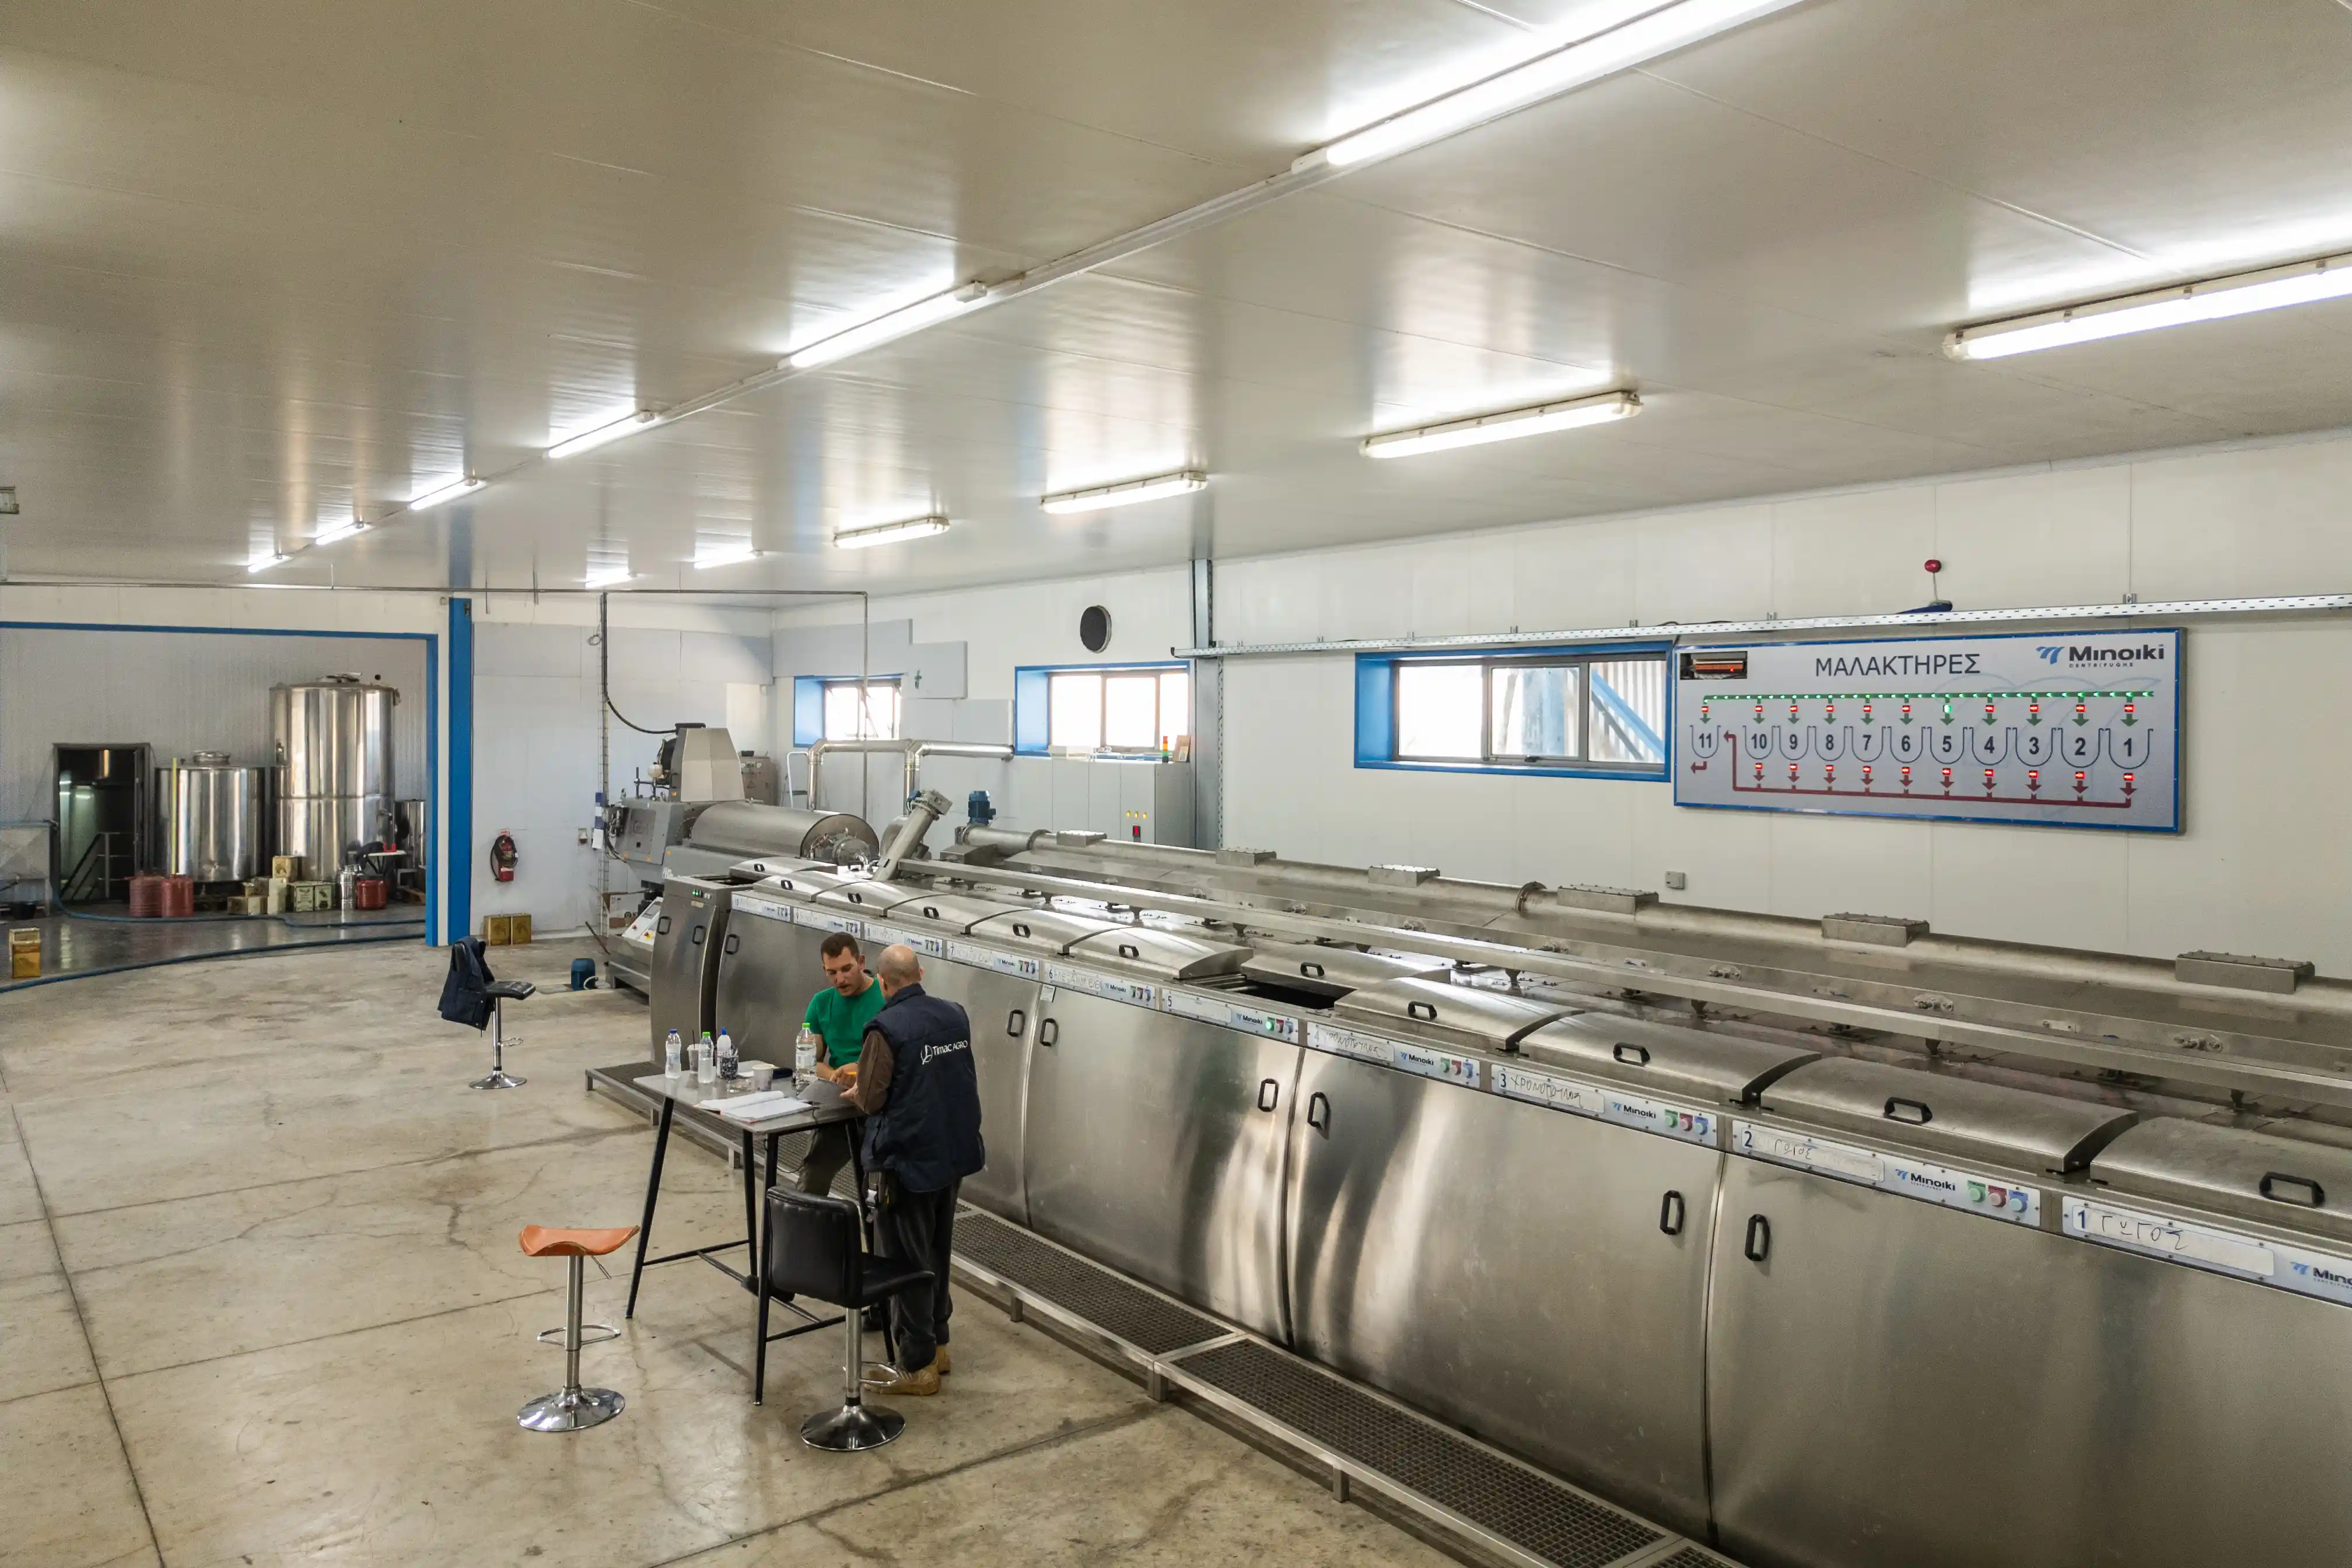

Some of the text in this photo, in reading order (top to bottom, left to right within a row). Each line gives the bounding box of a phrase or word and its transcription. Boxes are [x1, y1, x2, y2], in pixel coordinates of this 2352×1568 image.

[1816, 653, 1980, 676] ΜΑΛΑΚΤΗΡΕΣ
[1698, 733, 2132, 757] 11 10 9 8 7 6 5 4 3 2 1
[950, 946, 954, 956] 7
[1049, 968, 1053, 979] 6
[1168, 995, 1172, 1007] 5
[953, 1040, 968, 1051] AGRO
[1500, 1073, 1506, 1088] 3
[1744, 1130, 1752, 1148] 2
[2078, 1209, 2085, 1229] 1
